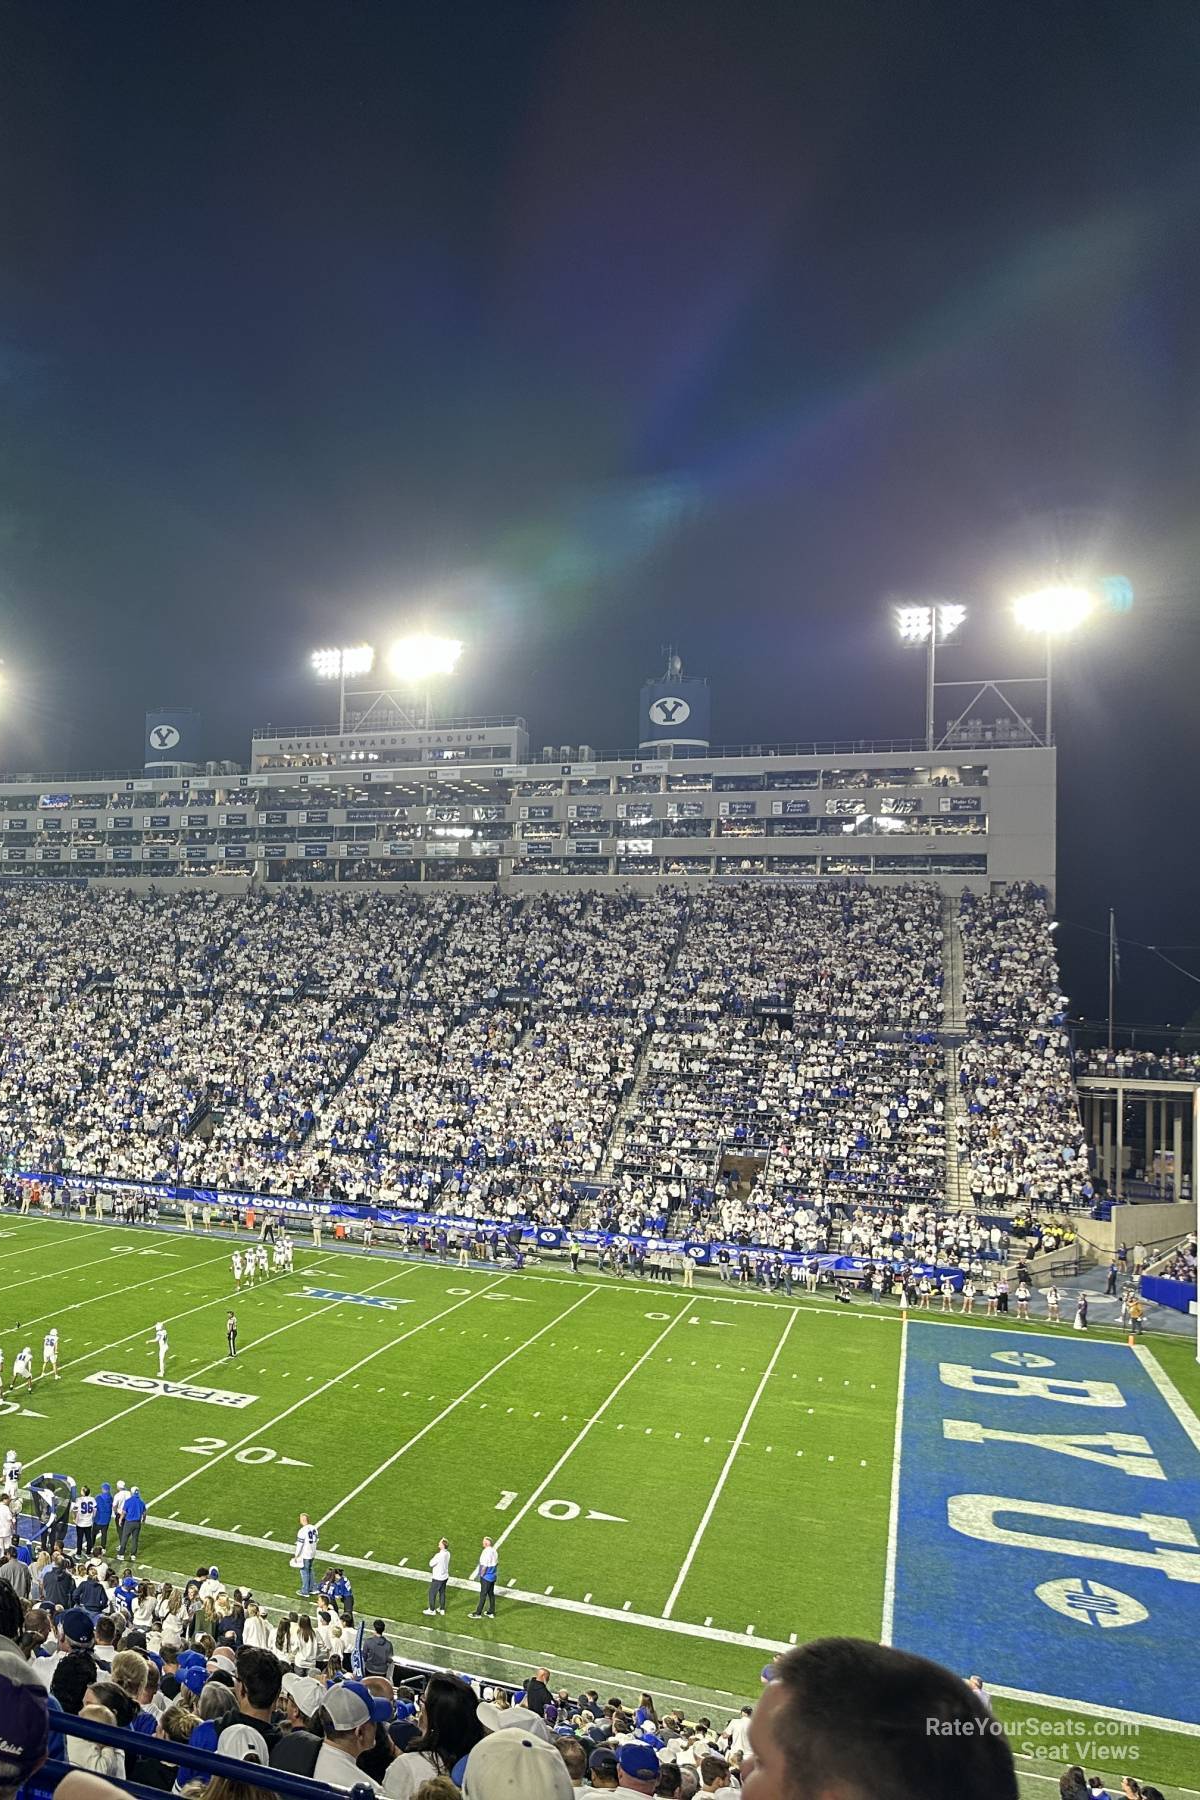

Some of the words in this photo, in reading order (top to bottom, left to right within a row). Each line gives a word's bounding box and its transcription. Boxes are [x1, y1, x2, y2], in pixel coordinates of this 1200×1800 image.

[656, 701, 683, 722] Y
[154, 728, 175, 747] Y
[279, 741, 329, 751] LAVELL
[340, 737, 407, 747] EDWARDS
[418, 734, 487, 744] STADIUM
[217, 1194, 250, 1206] BYU
[252, 1197, 331, 1214] COUGARS
[45, 1338, 55, 1348] 26
[97, 1373, 215, 1400] PACS
[179, 1437, 277, 1464] 20
[8, 1469, 19, 1480] 45
[939, 1362, 1200, 1584] BYU
[80, 1501, 94, 1514] 96
[494, 1490, 581, 1521] 10
